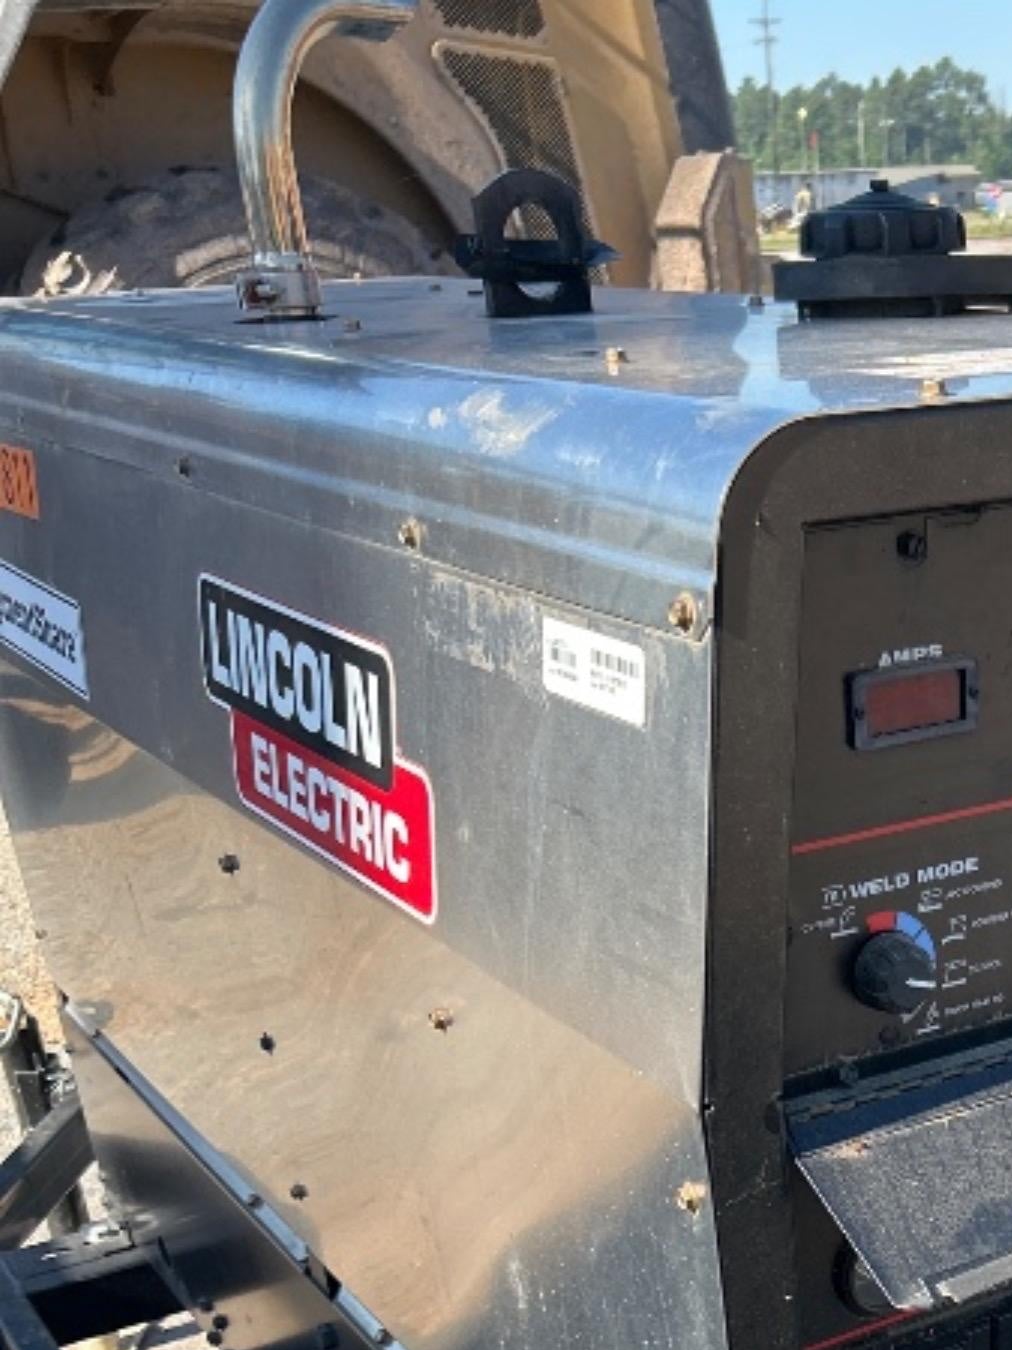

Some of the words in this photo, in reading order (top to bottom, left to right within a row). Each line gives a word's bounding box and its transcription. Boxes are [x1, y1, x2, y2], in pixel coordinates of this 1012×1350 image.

[207, 600, 382, 768] LINCOLN
[878, 643, 943, 668] AMPS
[250, 733, 410, 884] ELECTRIC
[849, 872, 911, 898] WELD
[917, 857, 980, 883] MODE
